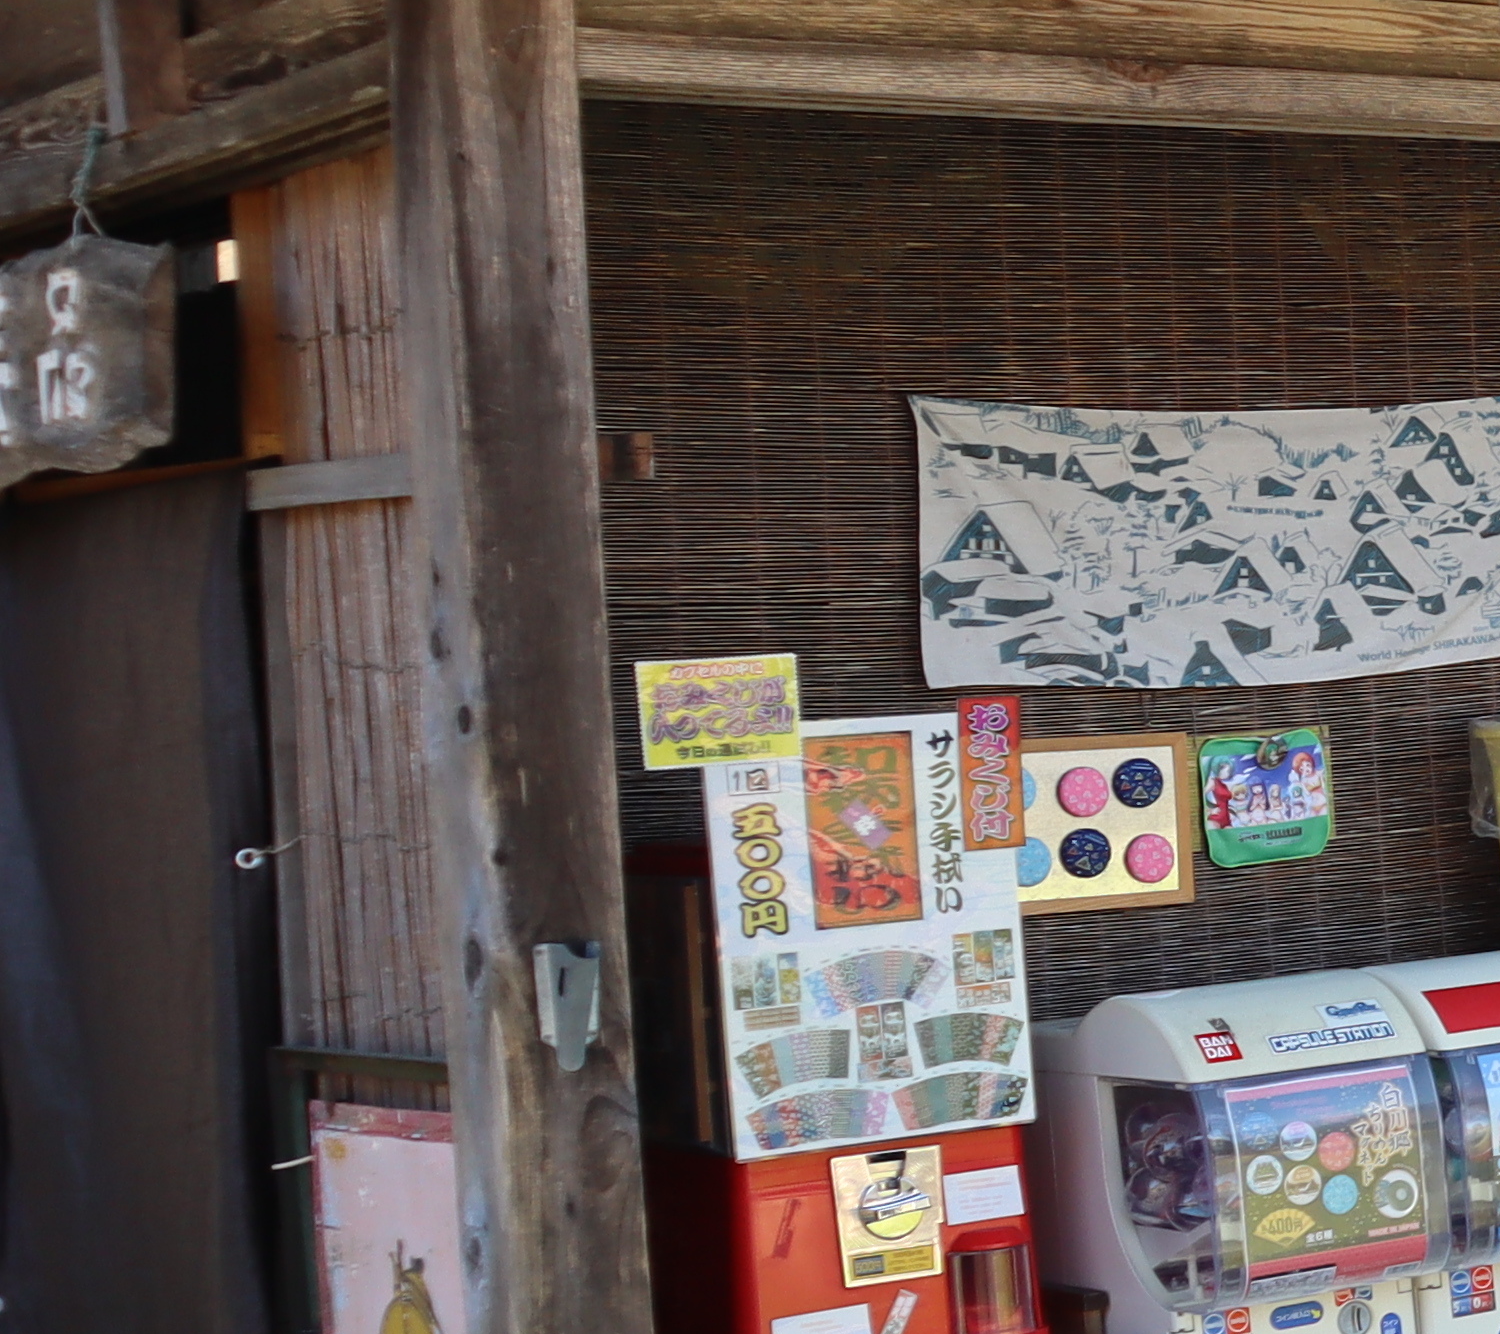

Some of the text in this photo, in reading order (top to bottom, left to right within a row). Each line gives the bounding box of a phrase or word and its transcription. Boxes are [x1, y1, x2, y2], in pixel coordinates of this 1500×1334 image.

[1358, 650, 1392, 663] World
[966, 703, 1015, 842] おみくじ付
[926, 729, 964, 914] サラシ手拭い
[1366, 1104, 1388, 1165] ちりめん
[1380, 1083, 1412, 1156] 白川郷
